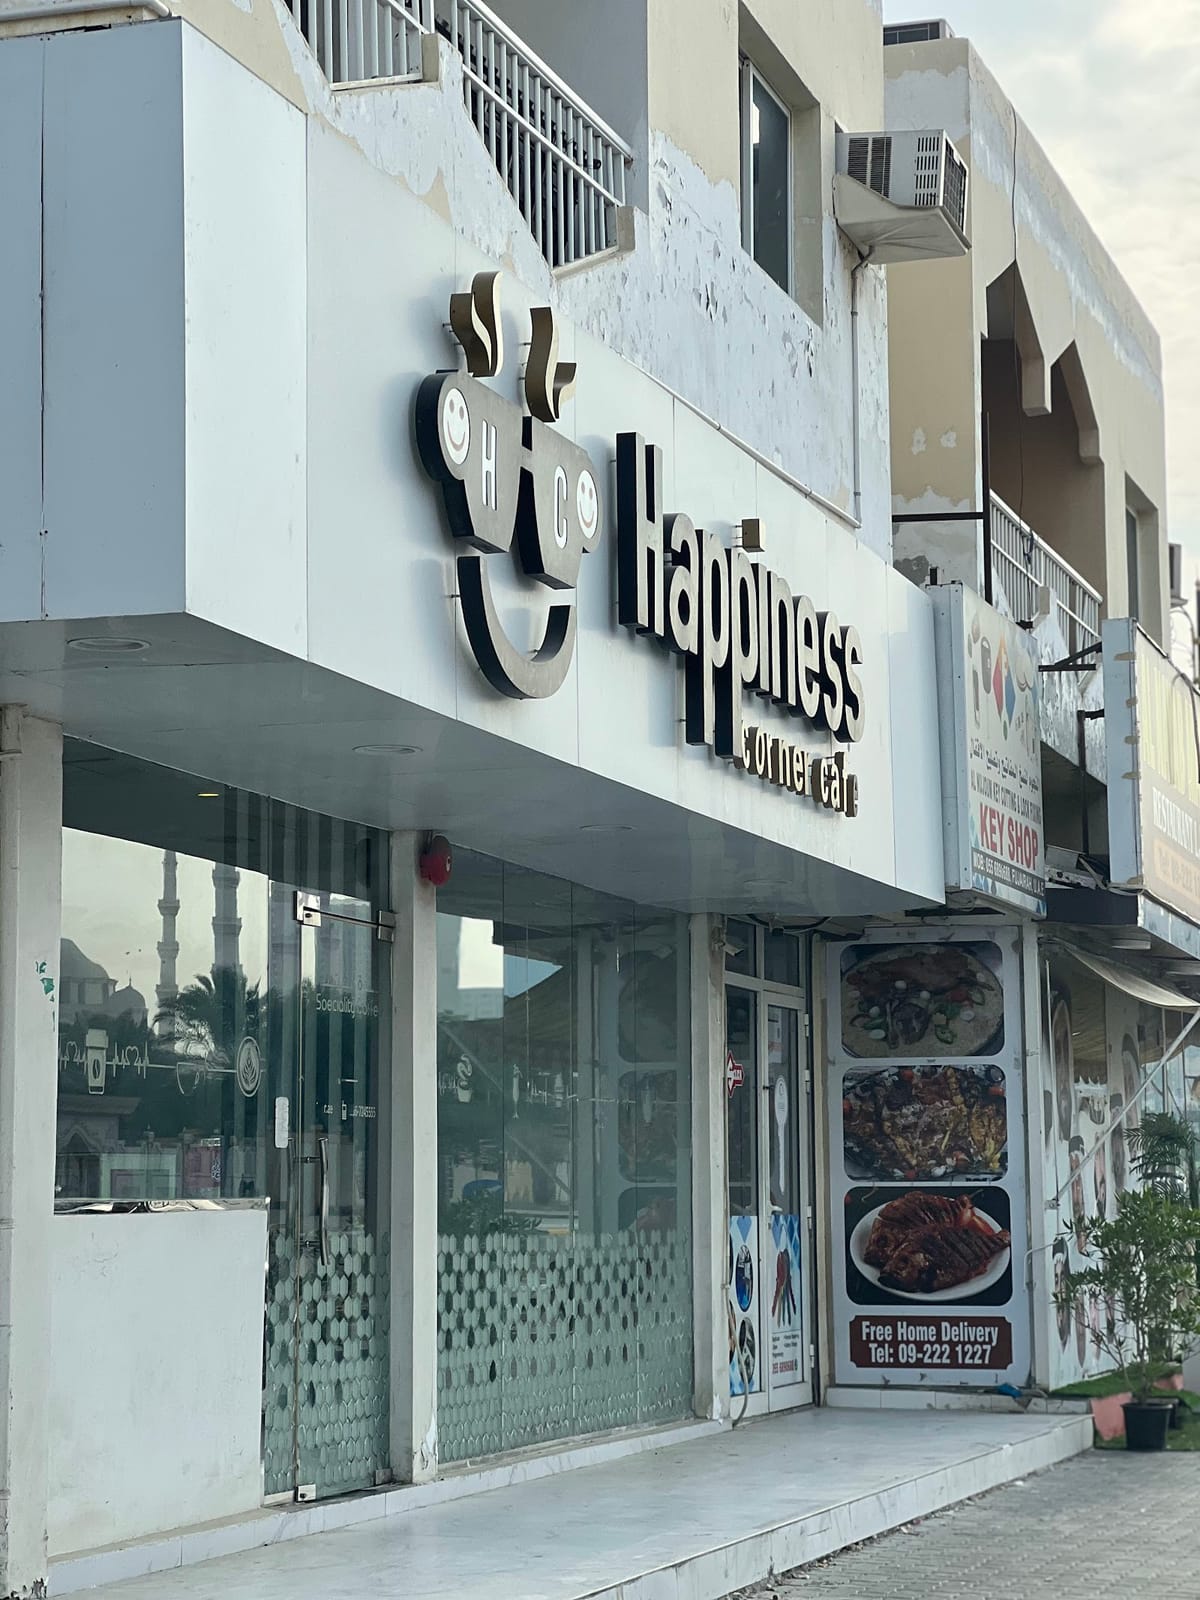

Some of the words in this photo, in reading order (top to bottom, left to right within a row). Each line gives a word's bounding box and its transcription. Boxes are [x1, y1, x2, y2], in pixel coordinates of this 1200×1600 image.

[481, 419, 498, 511] H
[553, 465, 568, 549] C
[616, 432, 866, 759] Happiness
[739, 722, 810, 797] corner
[815, 751, 859, 817] cafe
[980, 802, 1005, 856] KEY
[1007, 816, 1038, 871] SHOP
[861, 1320, 893, 1341] Free
[897, 1321, 936, 1342] Home
[941, 1321, 999, 1346] Delivery
[869, 1343, 894, 1363] Tel:
[898, 1343, 950, 1364] 09-222
[955, 1344, 992, 1364] 1227
